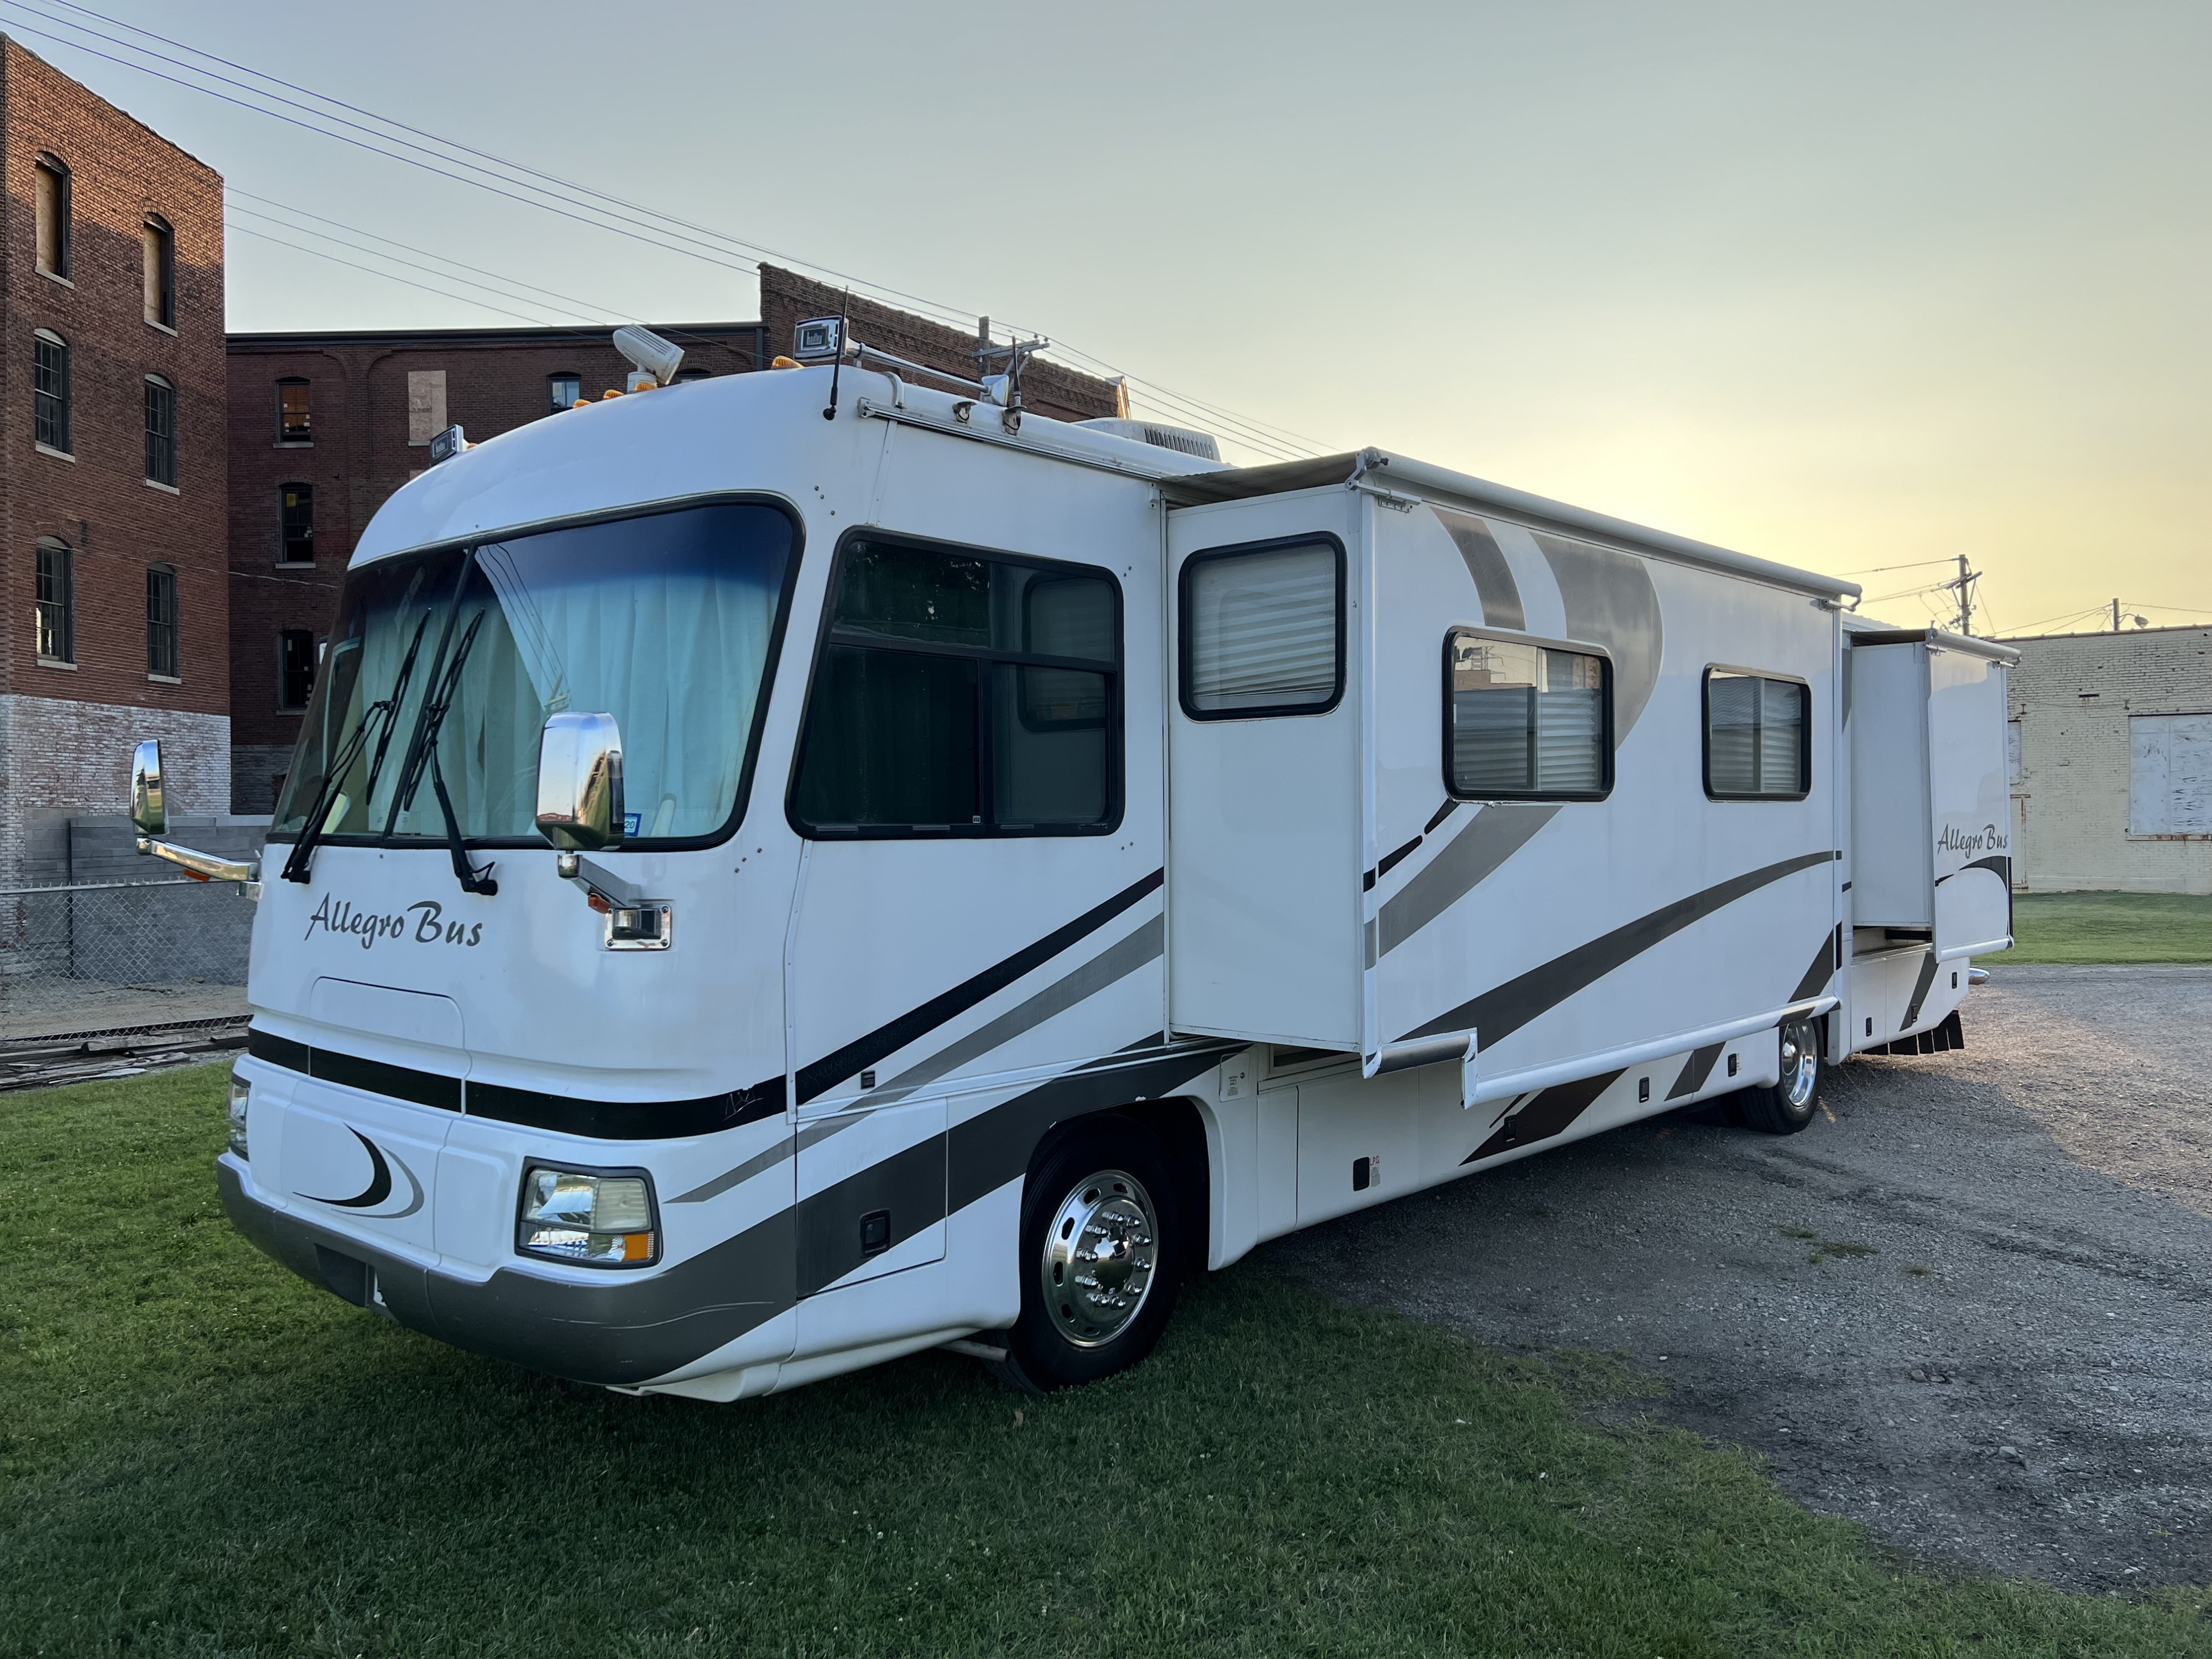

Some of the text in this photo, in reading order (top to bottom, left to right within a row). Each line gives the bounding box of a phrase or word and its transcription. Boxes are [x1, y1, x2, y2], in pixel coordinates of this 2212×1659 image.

[624, 821, 635, 829] 20
[1937, 823, 2008, 859] Allegro Bus
[305, 892, 483, 950] Allegro Bus
